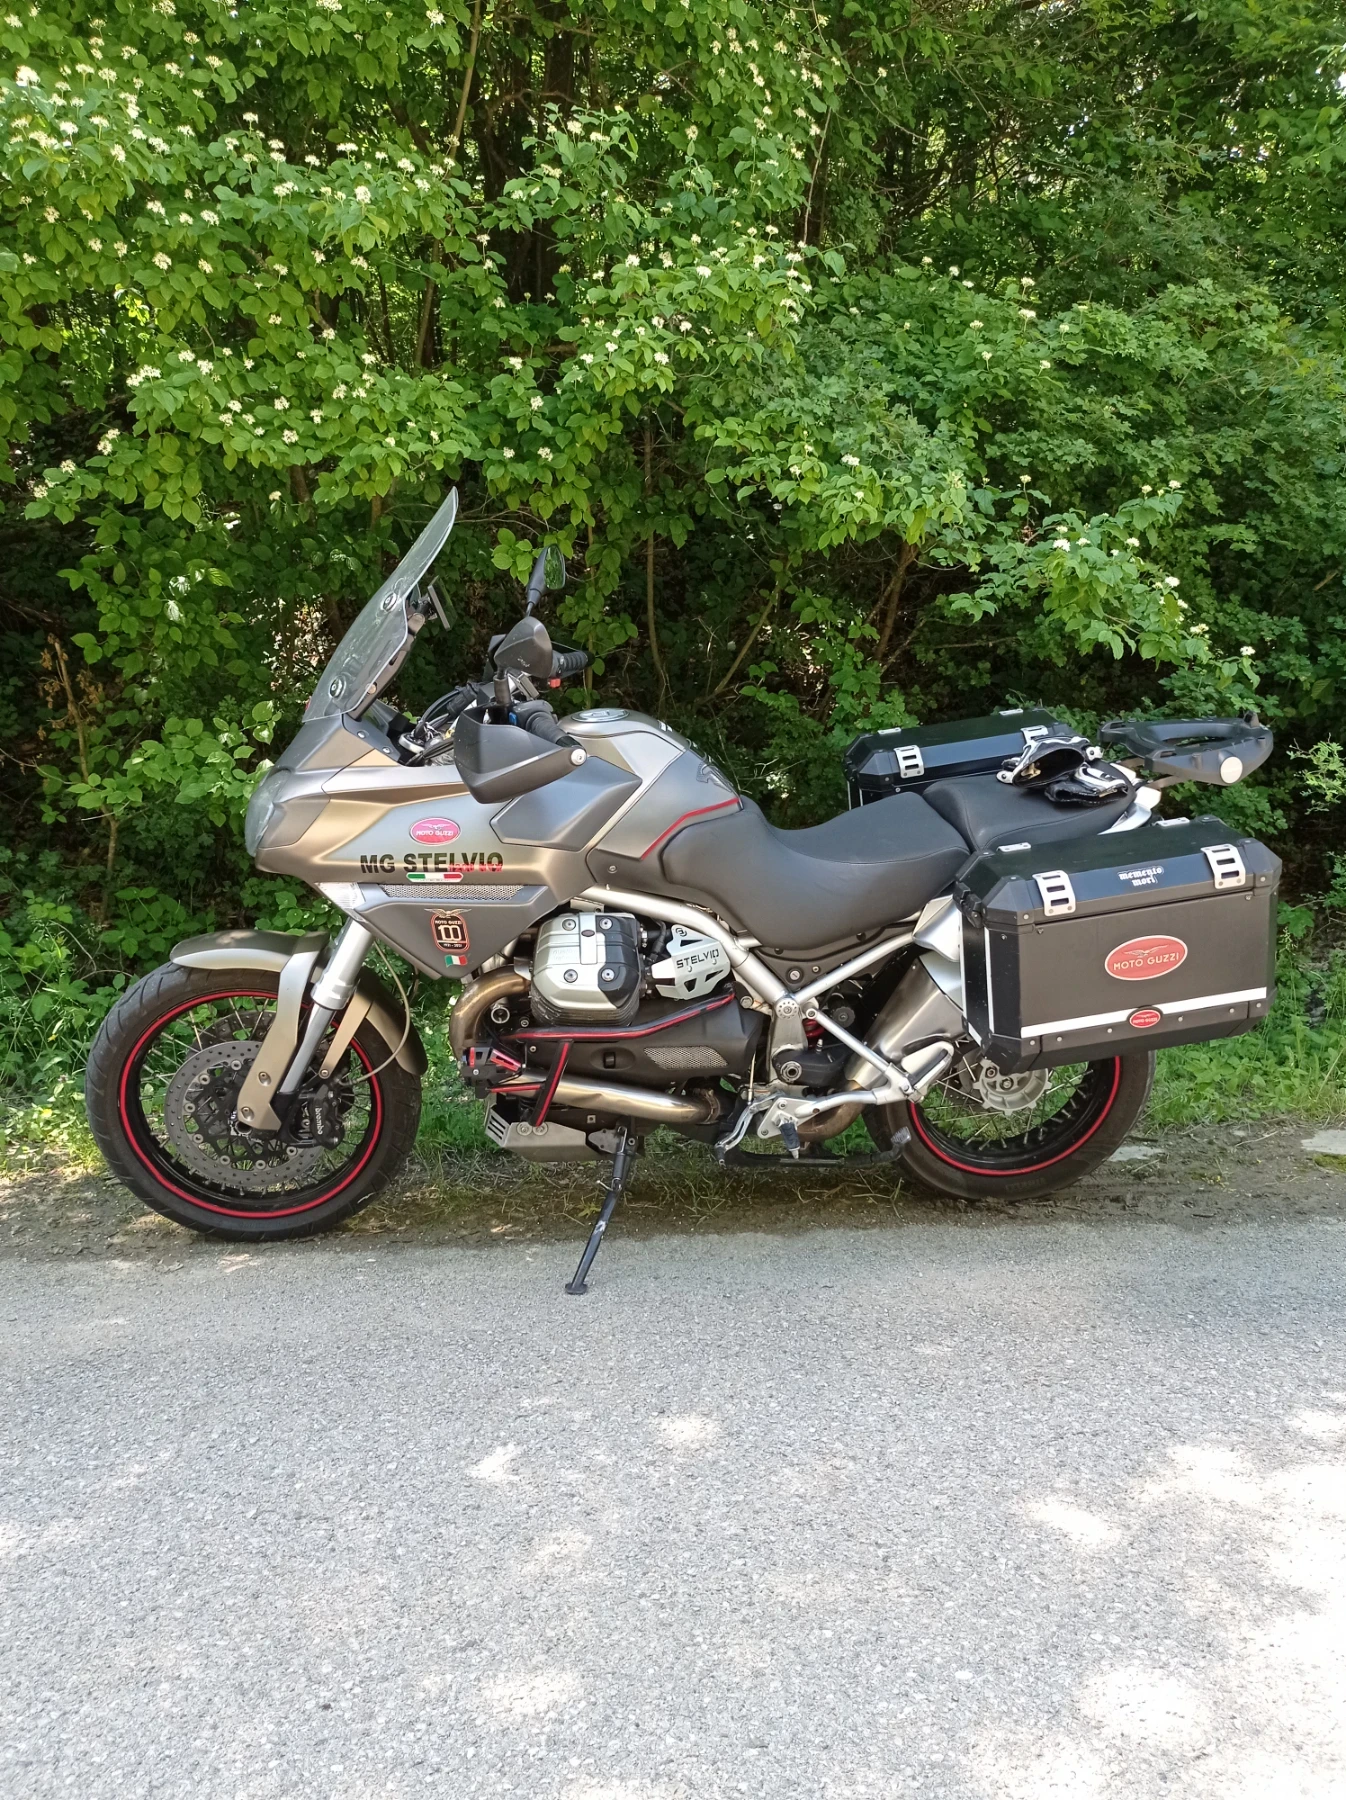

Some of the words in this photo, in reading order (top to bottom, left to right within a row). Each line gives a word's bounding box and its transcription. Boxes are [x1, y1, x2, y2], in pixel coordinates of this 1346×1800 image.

[360, 854, 396, 874] MG
[403, 852, 504, 873] STELVIO
[1118, 867, 1163, 880] memento
[1131, 875, 1156, 886] mori
[437, 925, 462, 941] 100
[676, 948, 720, 969] STELVIO
[1113, 958, 1144, 971] MOTO
[1147, 952, 1179, 965] GUZZI
[314, 1107, 324, 1135] brembo
